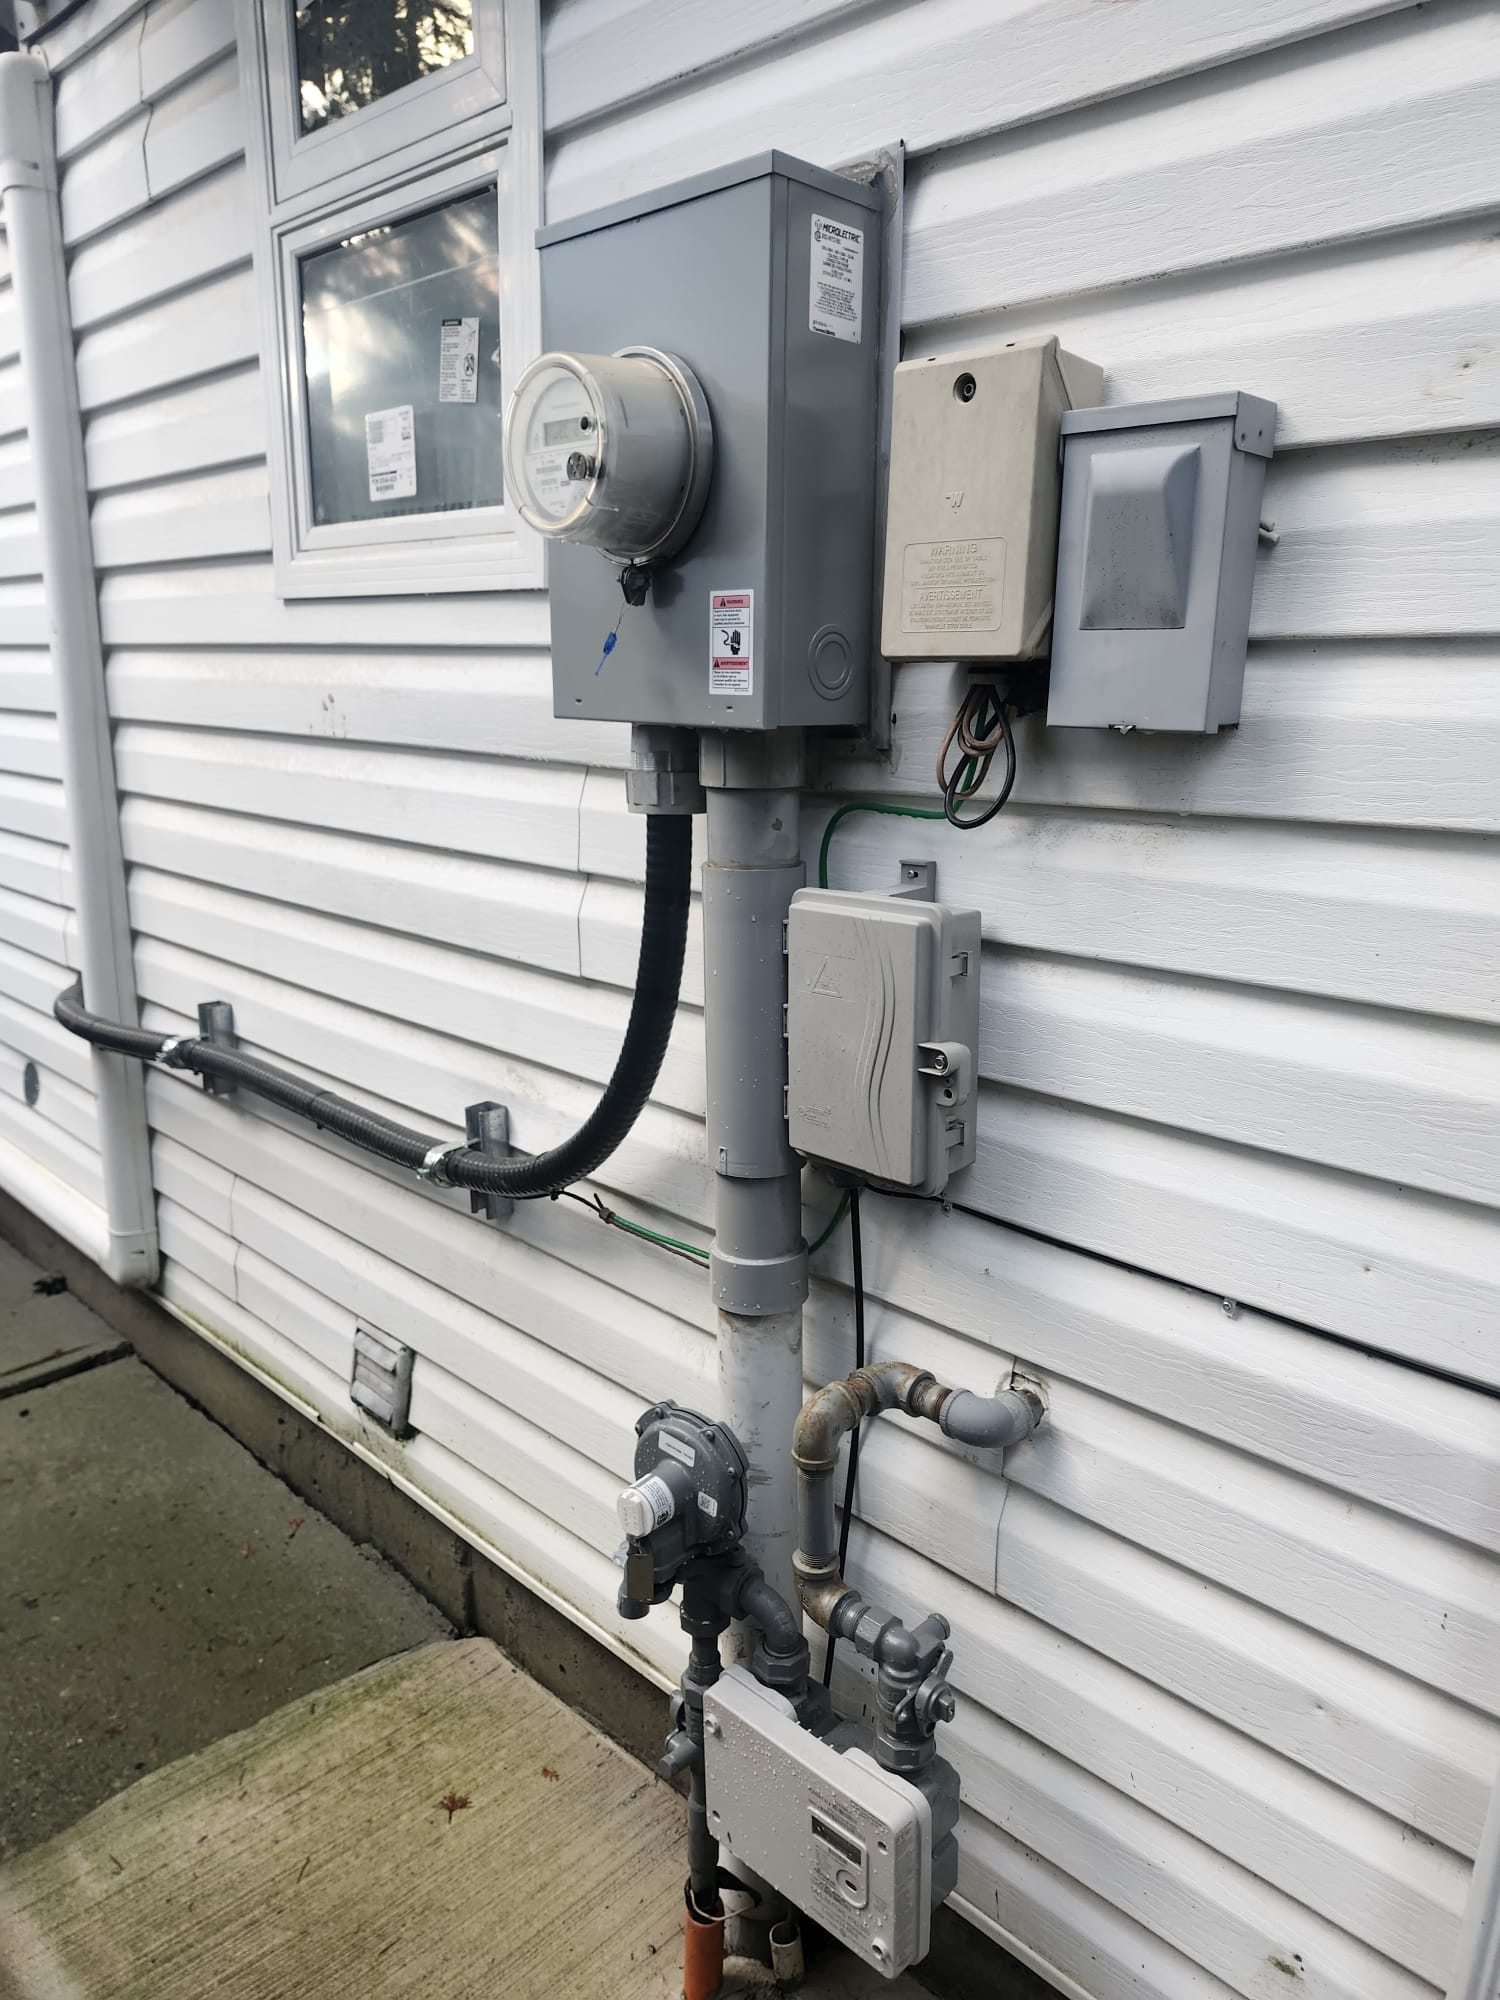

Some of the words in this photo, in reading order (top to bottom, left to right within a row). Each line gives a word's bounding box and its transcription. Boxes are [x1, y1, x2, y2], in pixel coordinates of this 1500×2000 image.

[822, 224, 861, 244] MICROLECTRIC
[931, 544, 978, 556] WARNING
[920, 589, 983, 601] AVERTISSEMENT
